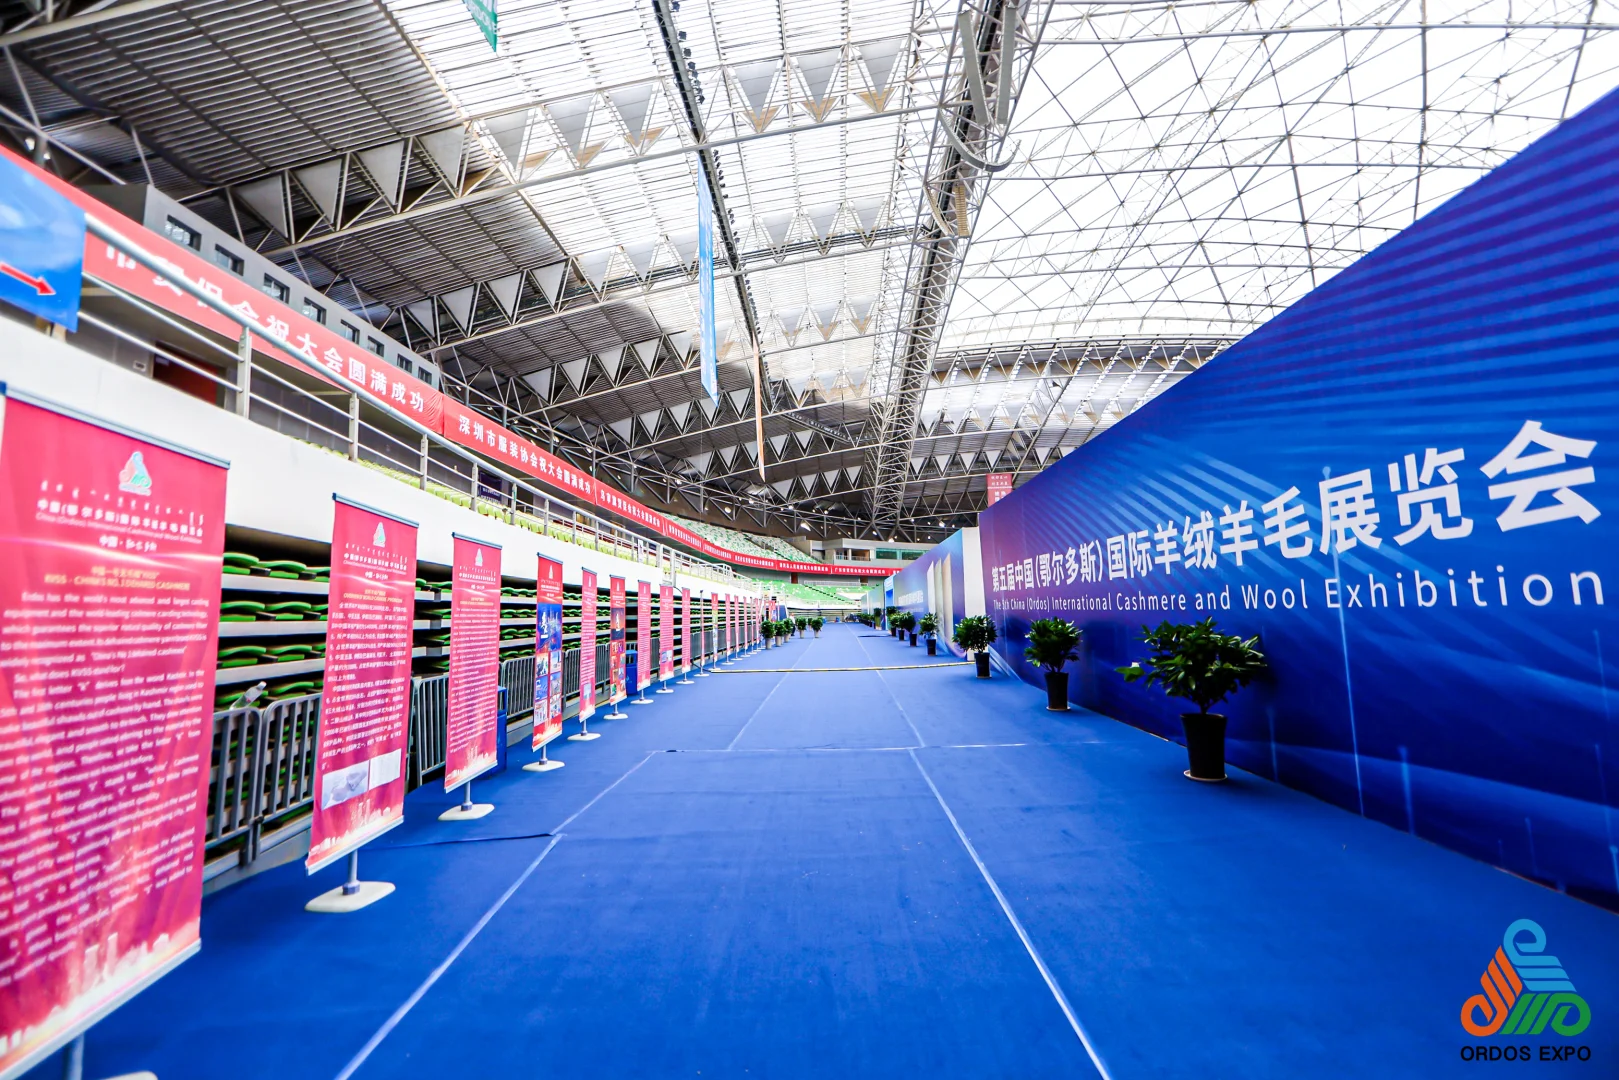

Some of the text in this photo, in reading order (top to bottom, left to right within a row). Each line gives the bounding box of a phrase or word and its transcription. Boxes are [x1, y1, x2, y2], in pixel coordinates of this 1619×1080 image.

[458, 414, 592, 495] 深圳市服装协会祝大会圆满成功
[993, 599, 1002, 610] The
[1010, 598, 1025, 610] China
[1026, 595, 1050, 613] (Ordos)
[1052, 592, 1112, 611] International
[1116, 590, 1187, 611] Cashmere
[1195, 582, 1231, 610] and
[1242, 579, 1308, 610] Wool
[1325, 565, 1604, 609] Exhibition
